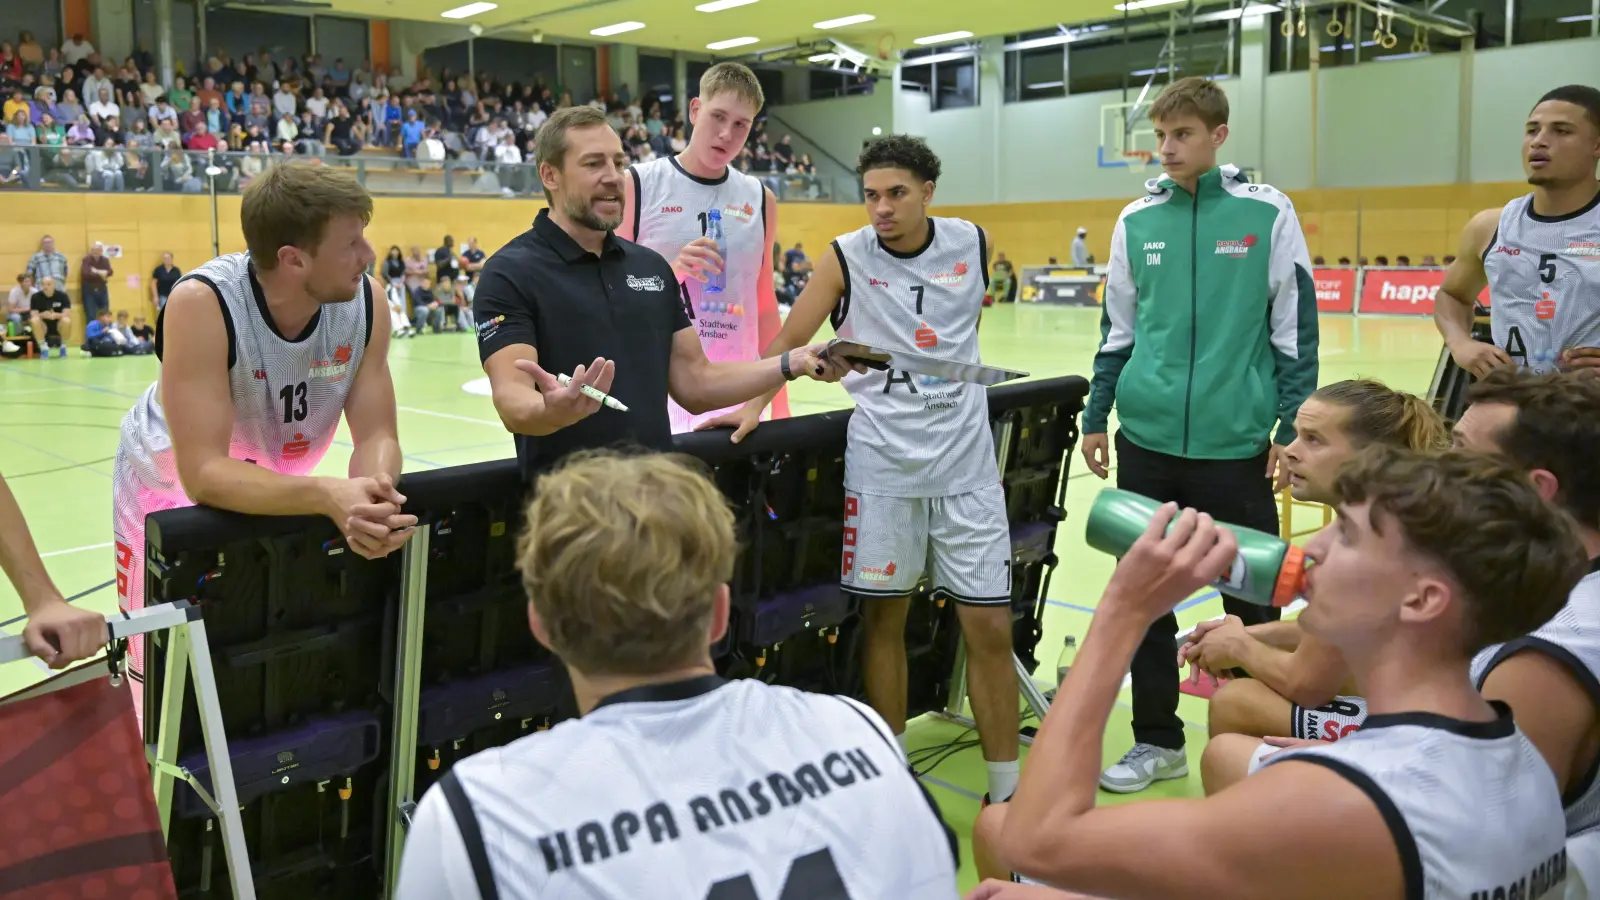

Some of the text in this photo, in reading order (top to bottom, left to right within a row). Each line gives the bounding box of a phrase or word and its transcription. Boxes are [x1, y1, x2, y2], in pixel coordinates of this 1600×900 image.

[1143, 242, 1166, 250] JAKO
[1147, 253, 1161, 266] DM
[1496, 246, 1520, 256] JAKO
[1538, 254, 1557, 284] 5
[910, 285, 924, 315] 7
[1505, 326, 1529, 367] A
[280, 381, 308, 423] 13
[923, 399, 958, 411] Ansbach
[537, 746, 882, 873] HAPA ANSBACH
